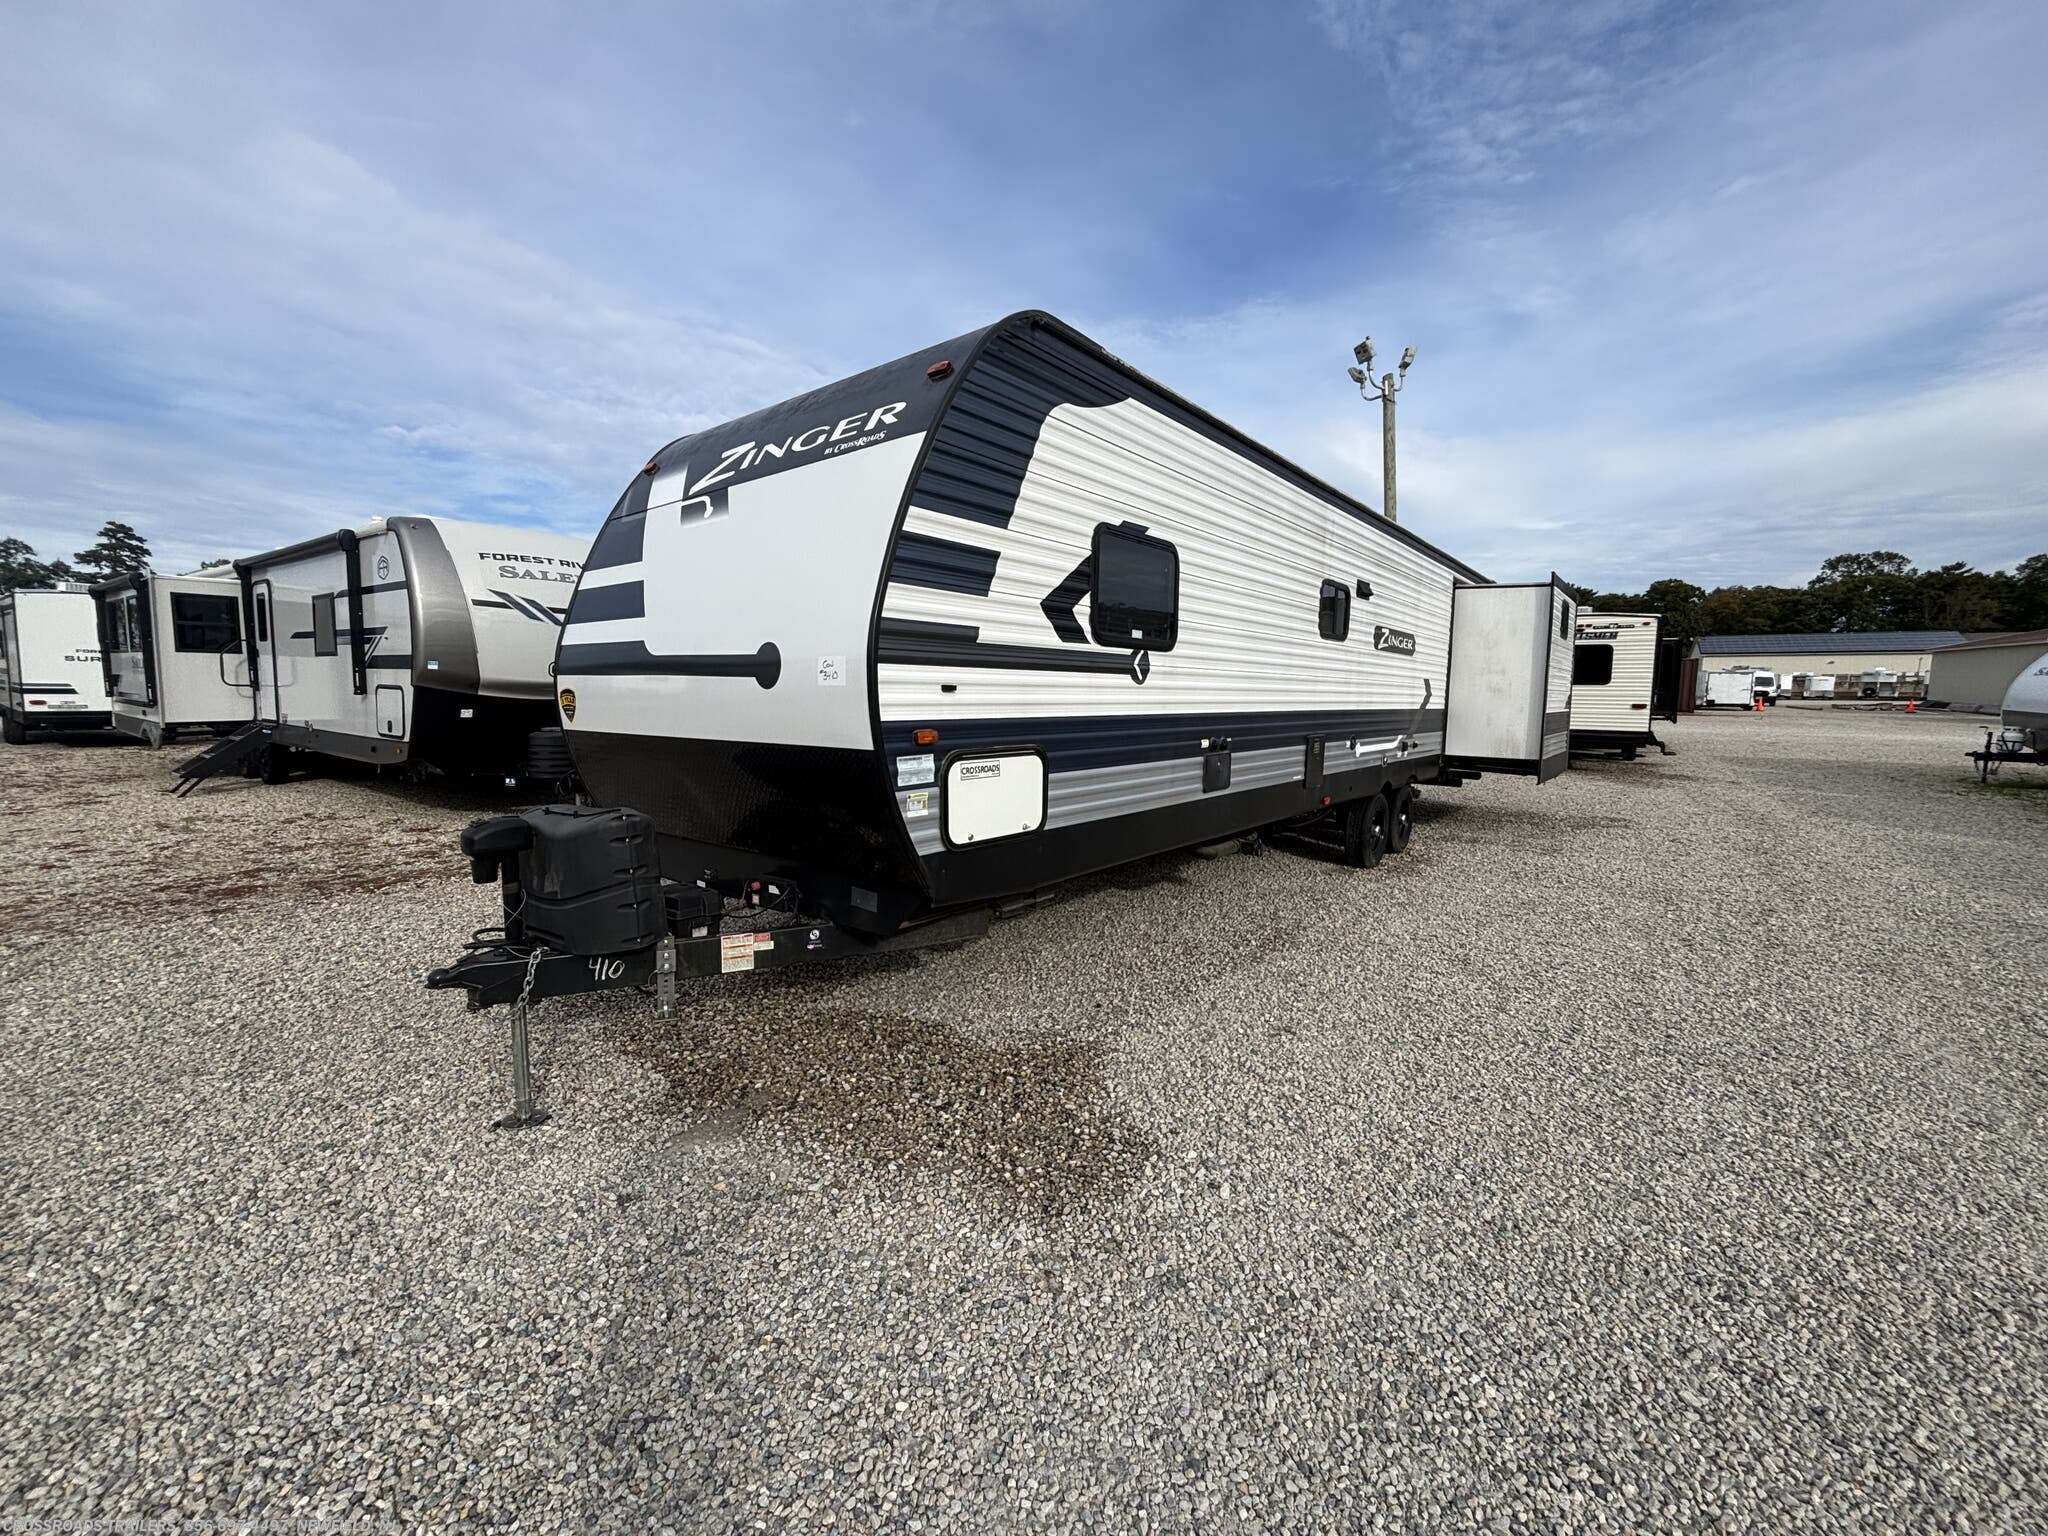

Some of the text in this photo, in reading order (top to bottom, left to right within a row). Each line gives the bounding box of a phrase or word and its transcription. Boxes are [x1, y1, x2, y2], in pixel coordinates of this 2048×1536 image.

[688, 401, 907, 496] ZINGER
[478, 552, 554, 565] FOREST
[498, 565, 581, 584] SALE
[1378, 628, 1413, 650] ZINGER
[961, 764, 1000, 775] CROSSROADS
[588, 956, 626, 981] 410
